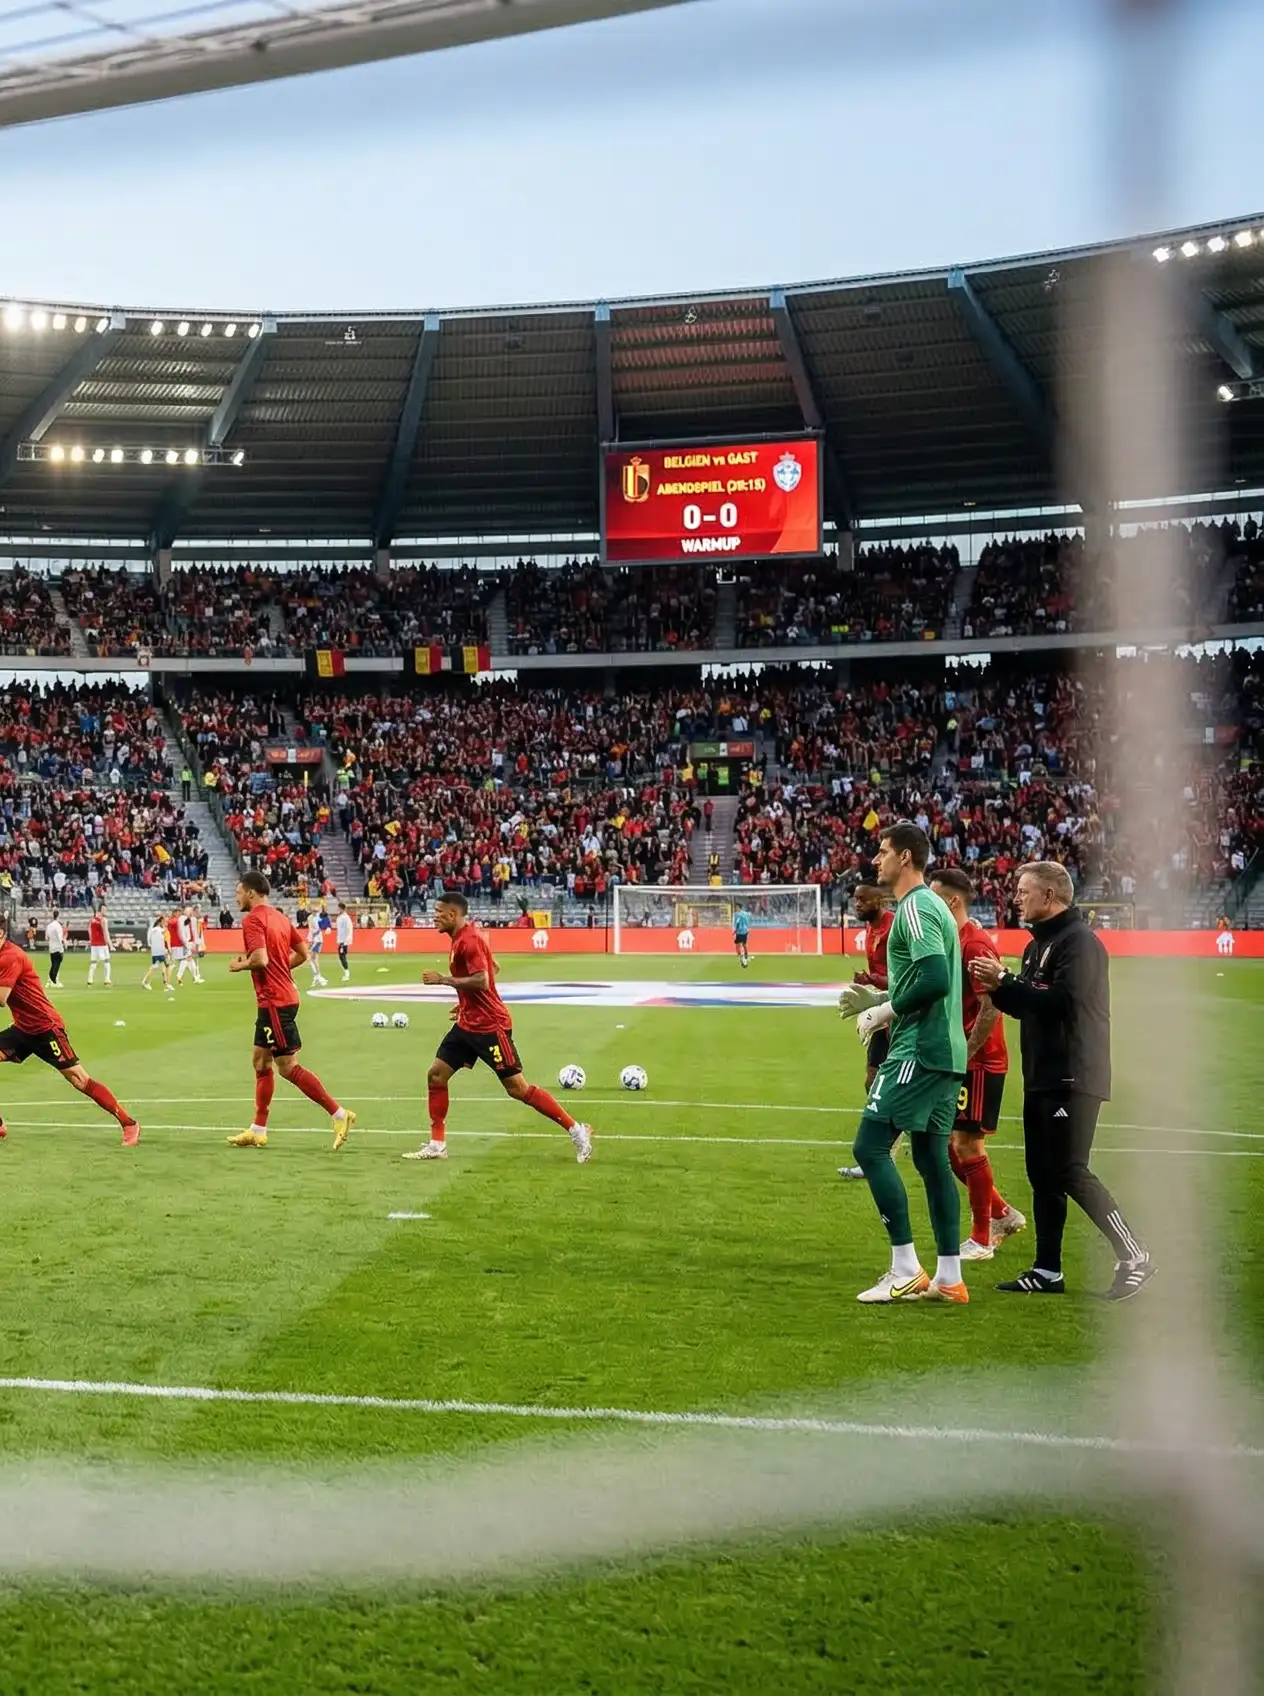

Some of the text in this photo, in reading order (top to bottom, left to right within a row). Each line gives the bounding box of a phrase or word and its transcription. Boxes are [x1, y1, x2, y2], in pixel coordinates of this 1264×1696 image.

[664, 454, 711, 469] BELGIEN
[727, 451, 759, 465] GAST
[681, 536, 741, 552] WARMUP
[263, 1026, 275, 1044] 2
[49, 1040, 62, 1057] 9
[871, 1074, 886, 1100] 1
